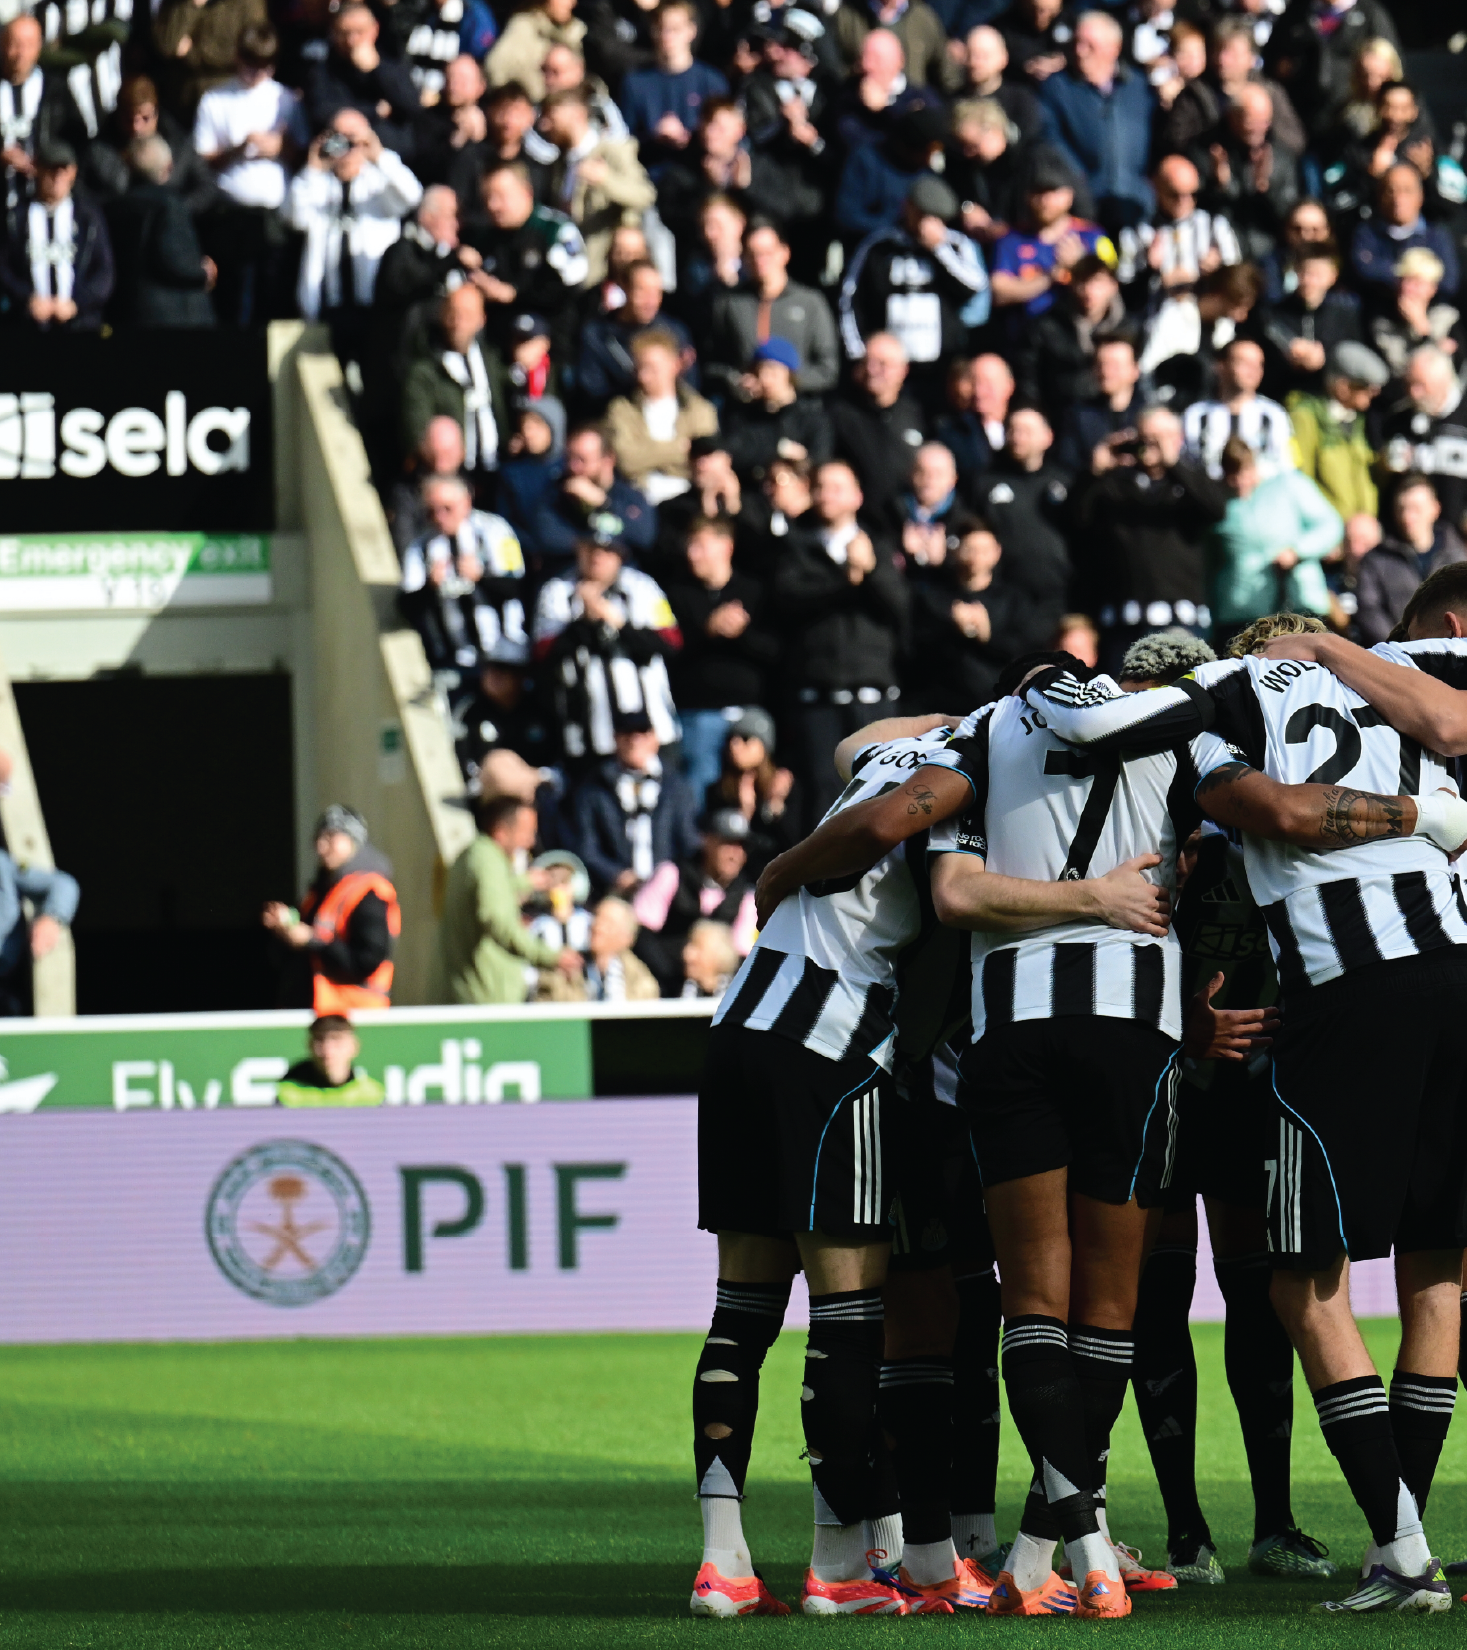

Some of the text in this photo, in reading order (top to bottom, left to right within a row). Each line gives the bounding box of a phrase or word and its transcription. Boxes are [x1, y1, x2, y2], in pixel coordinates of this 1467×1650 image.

[60, 389, 251, 478] sela
[1259, 660, 1316, 693] WOL
[1020, 711, 1047, 735] JO
[1044, 750, 1121, 881] 7
[396, 1162, 628, 1273] PIF
